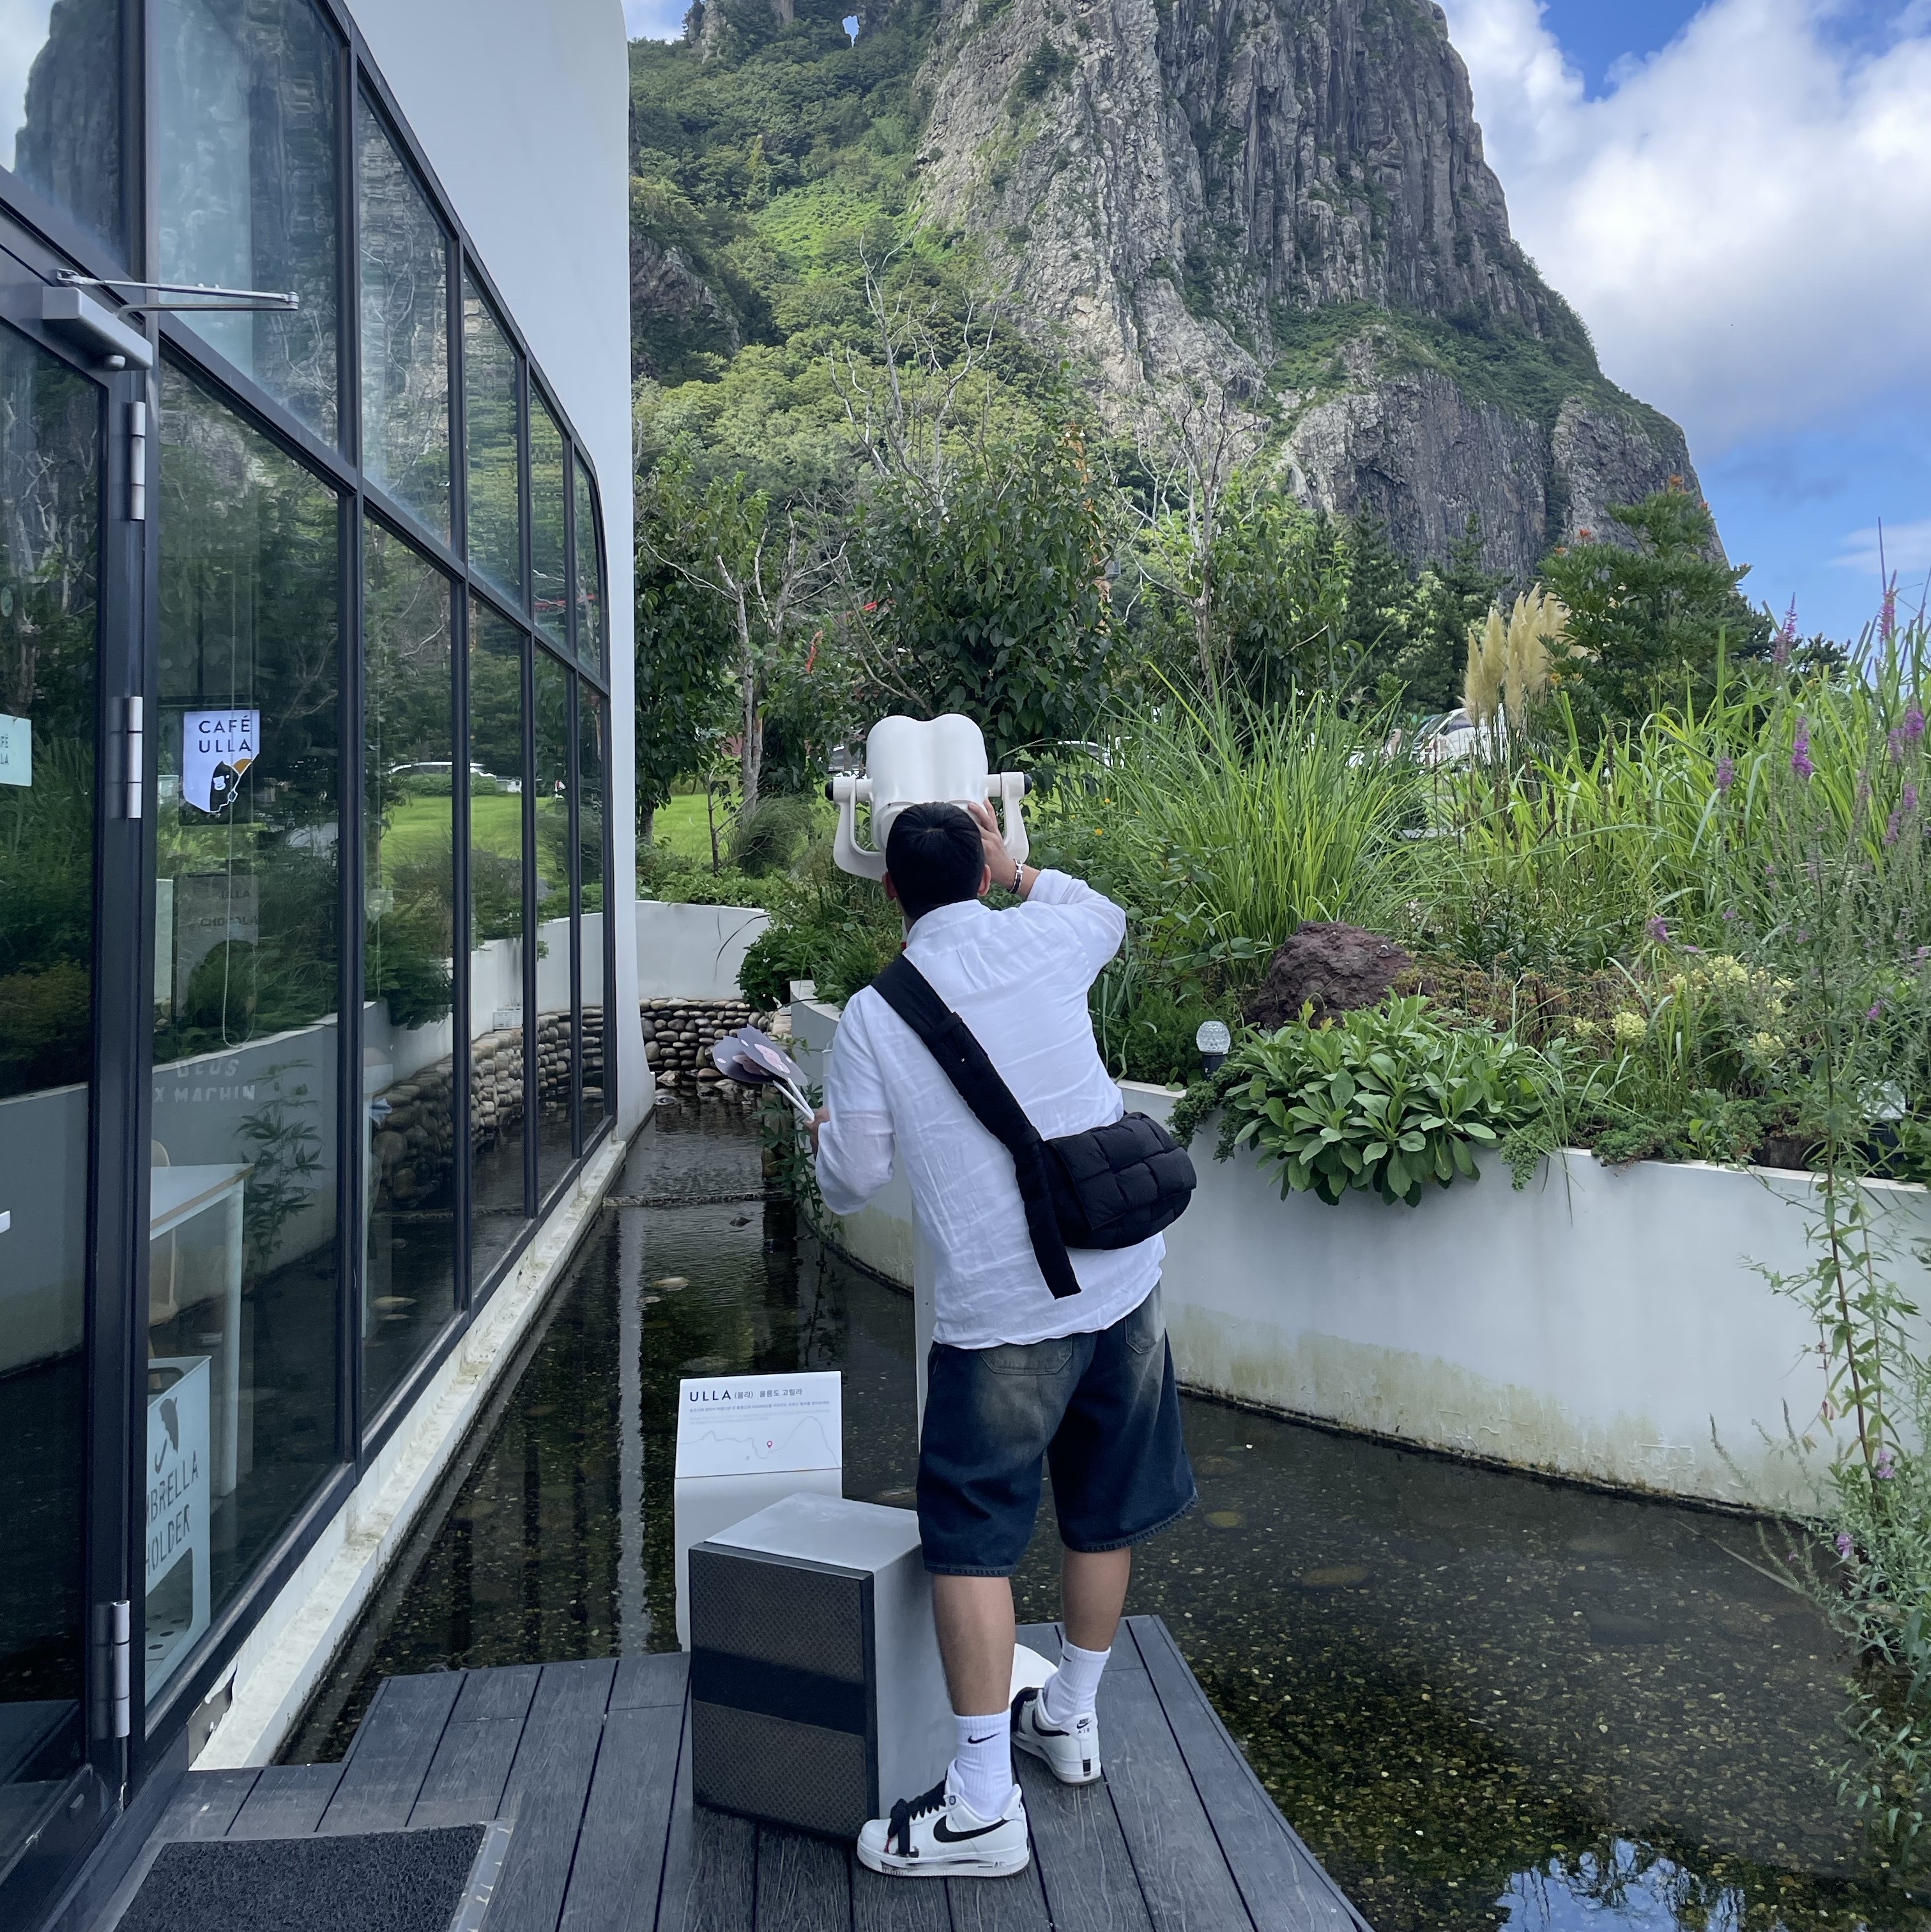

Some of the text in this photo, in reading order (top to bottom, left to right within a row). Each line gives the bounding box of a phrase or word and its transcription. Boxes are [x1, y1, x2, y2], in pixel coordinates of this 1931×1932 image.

[199, 715, 250, 733] CAFÉ
[199, 739, 252, 753] ULLA
[690, 1390, 731, 1402] ULLA
[759, 1390, 780, 1398] 울릉도
